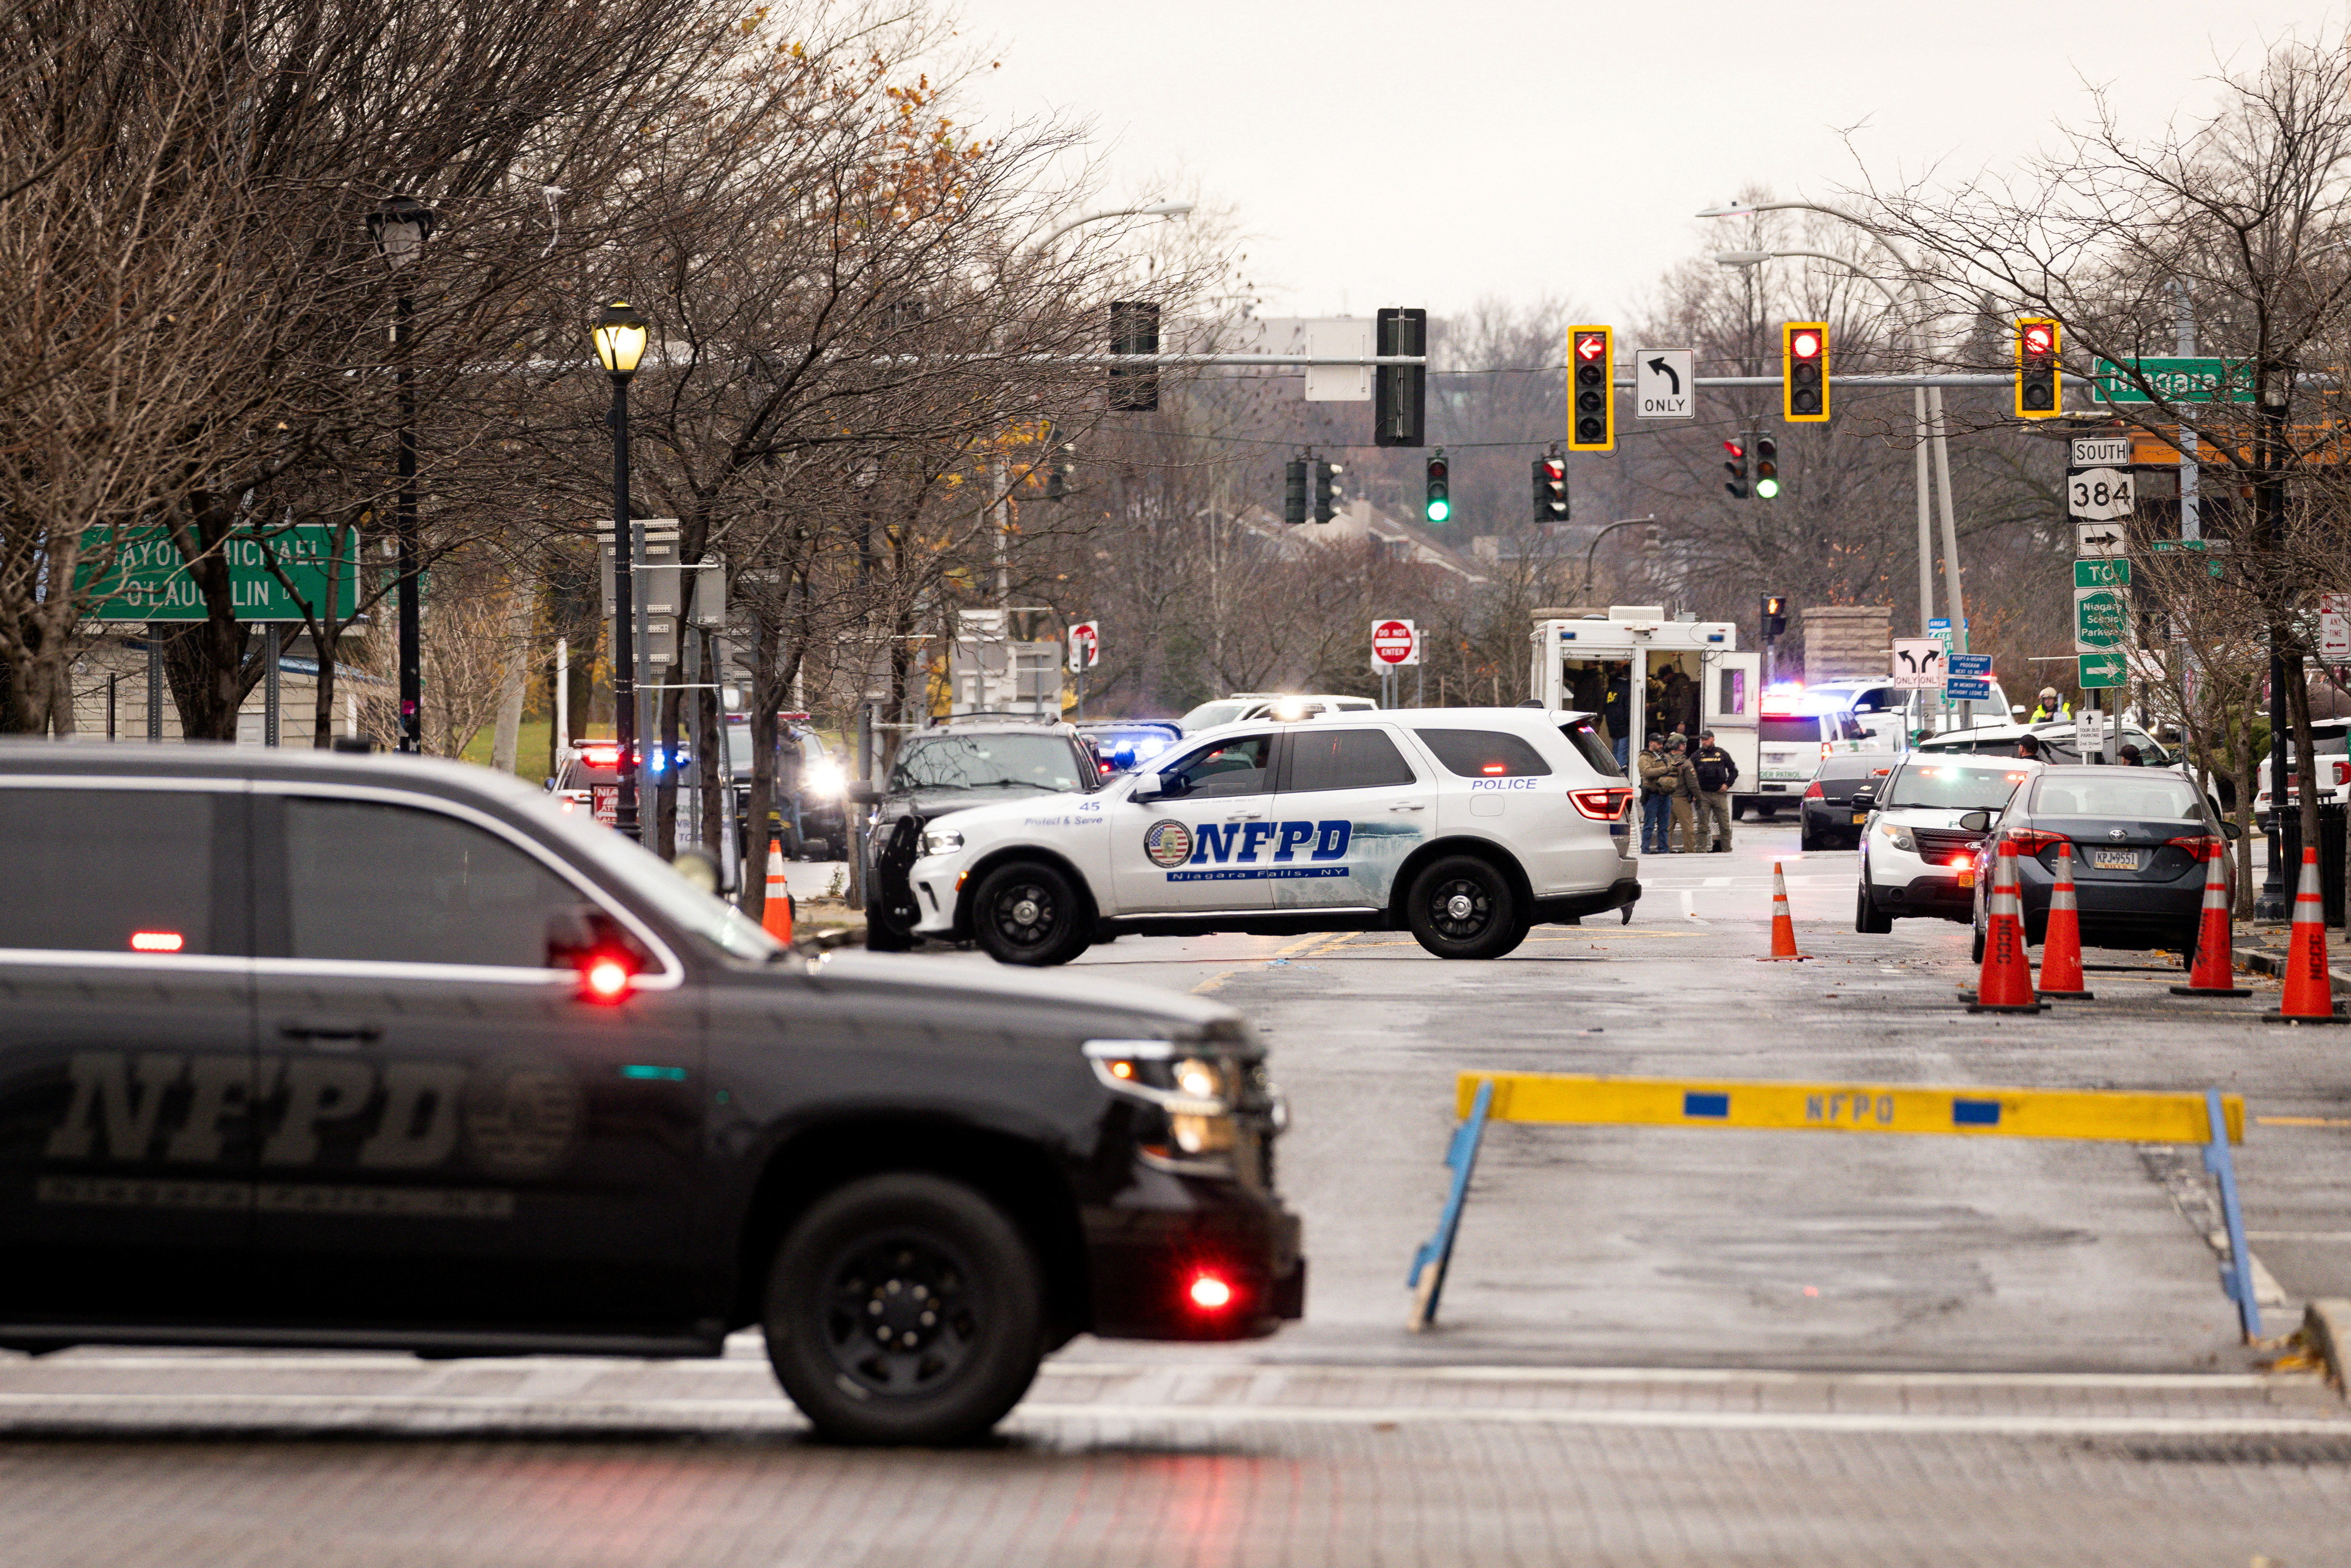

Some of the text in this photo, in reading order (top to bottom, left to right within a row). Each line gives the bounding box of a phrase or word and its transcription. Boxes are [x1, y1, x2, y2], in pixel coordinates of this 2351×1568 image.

[1645, 399, 1686, 411] ONLY
[2076, 444, 2126, 460] SOUTH
[2074, 481, 2131, 507] 384
[2088, 566, 2114, 581] TO
[2083, 602, 2122, 613] Niagara
[2087, 615, 2118, 623] Scenic
[1378, 628, 1406, 637] DO NOT
[1472, 779, 1537, 790] POLICE
[1079, 801, 1100, 811] 45
[1189, 820, 1352, 864] NFPD
[1173, 872, 1246, 880] Niagara
[2309, 933, 2322, 980] NCCC
[43, 1051, 468, 1168] NFPD
